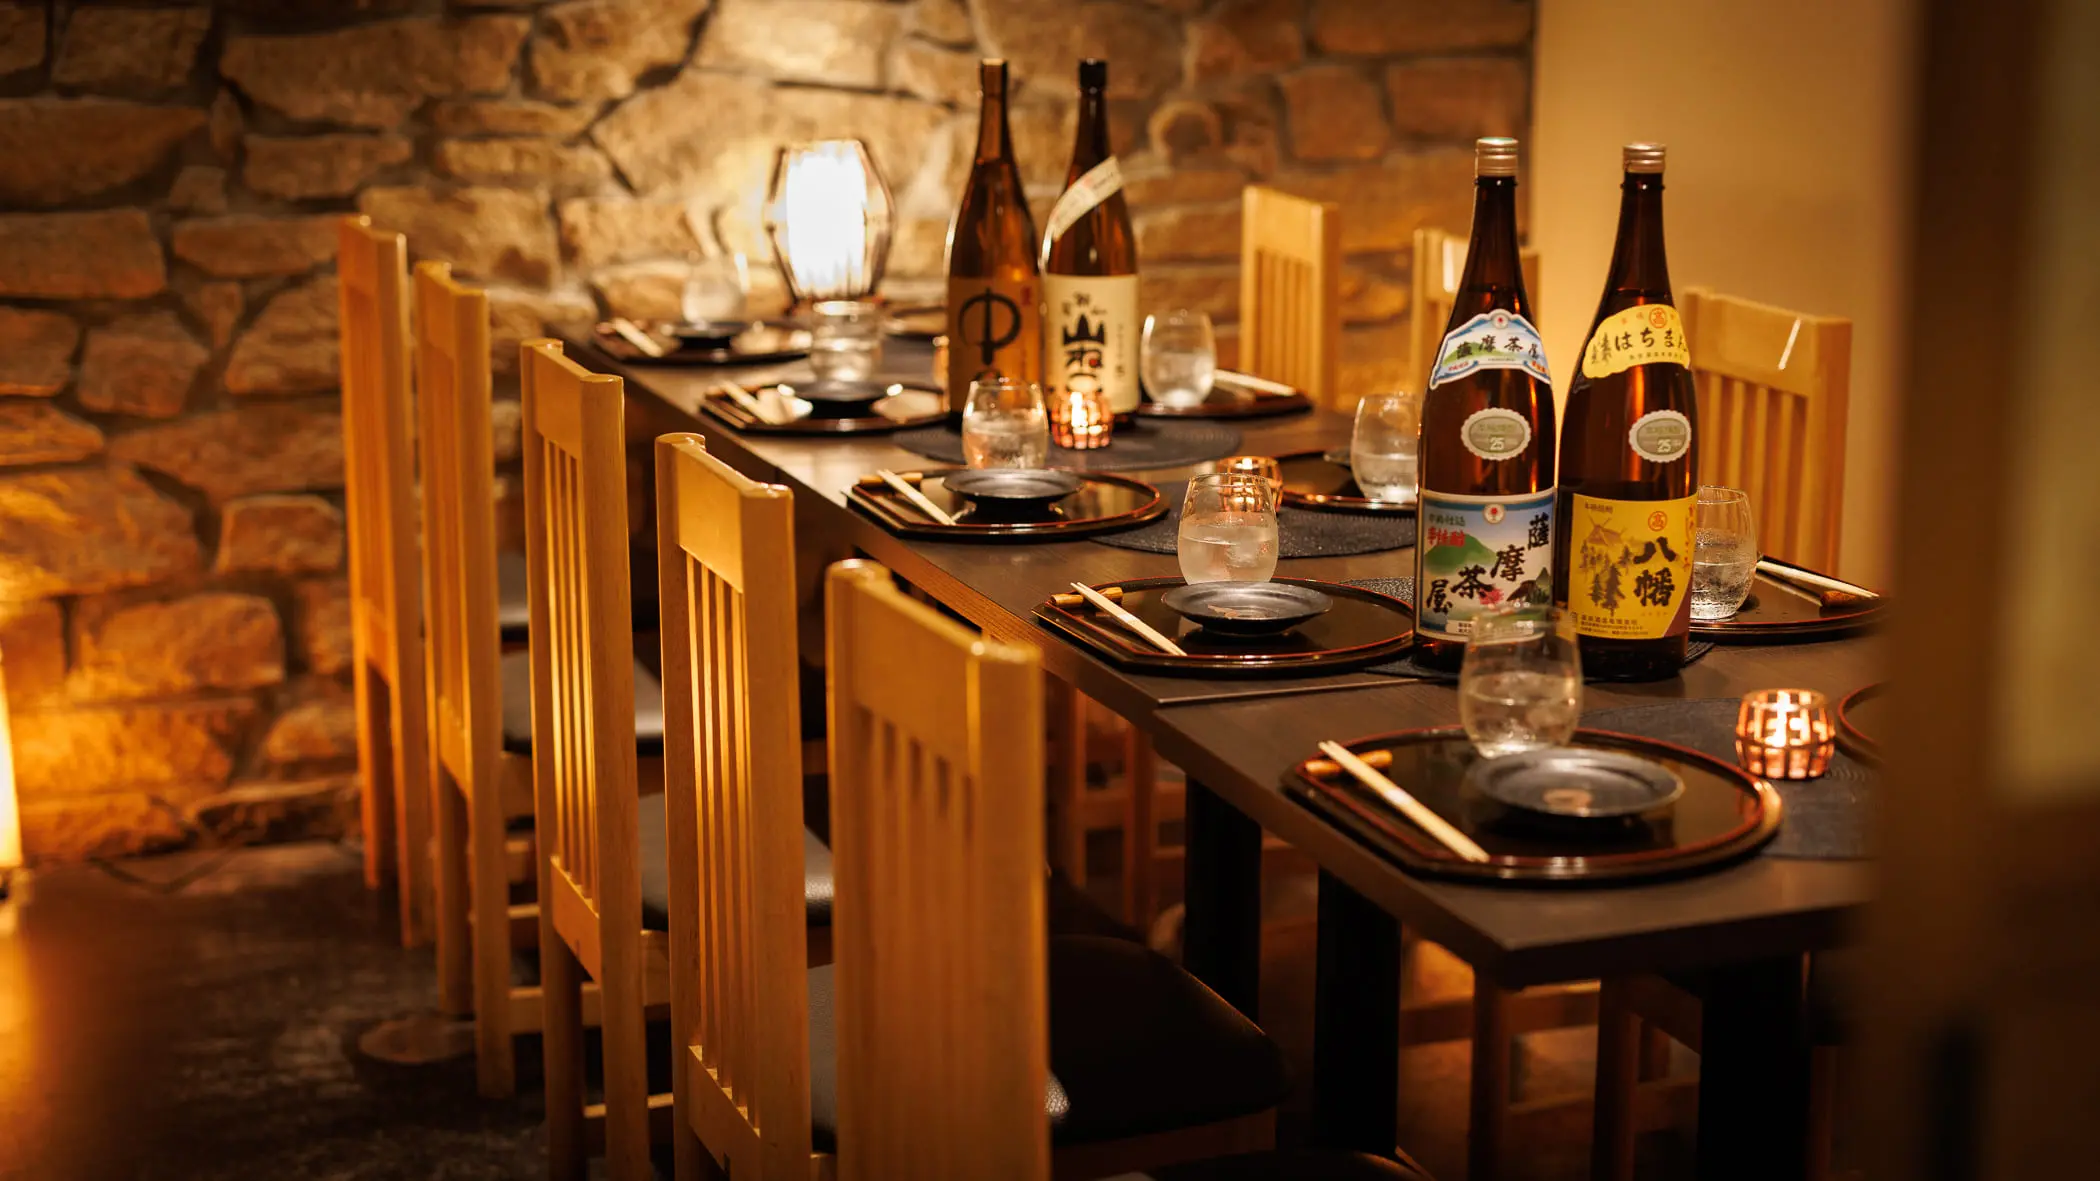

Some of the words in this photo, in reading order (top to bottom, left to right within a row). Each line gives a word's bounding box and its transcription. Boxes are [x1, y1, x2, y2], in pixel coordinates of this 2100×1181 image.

[1490, 436, 1505, 451] 25
[1657, 439, 1672, 454] 25
[1633, 536, 1677, 608] 八幡
